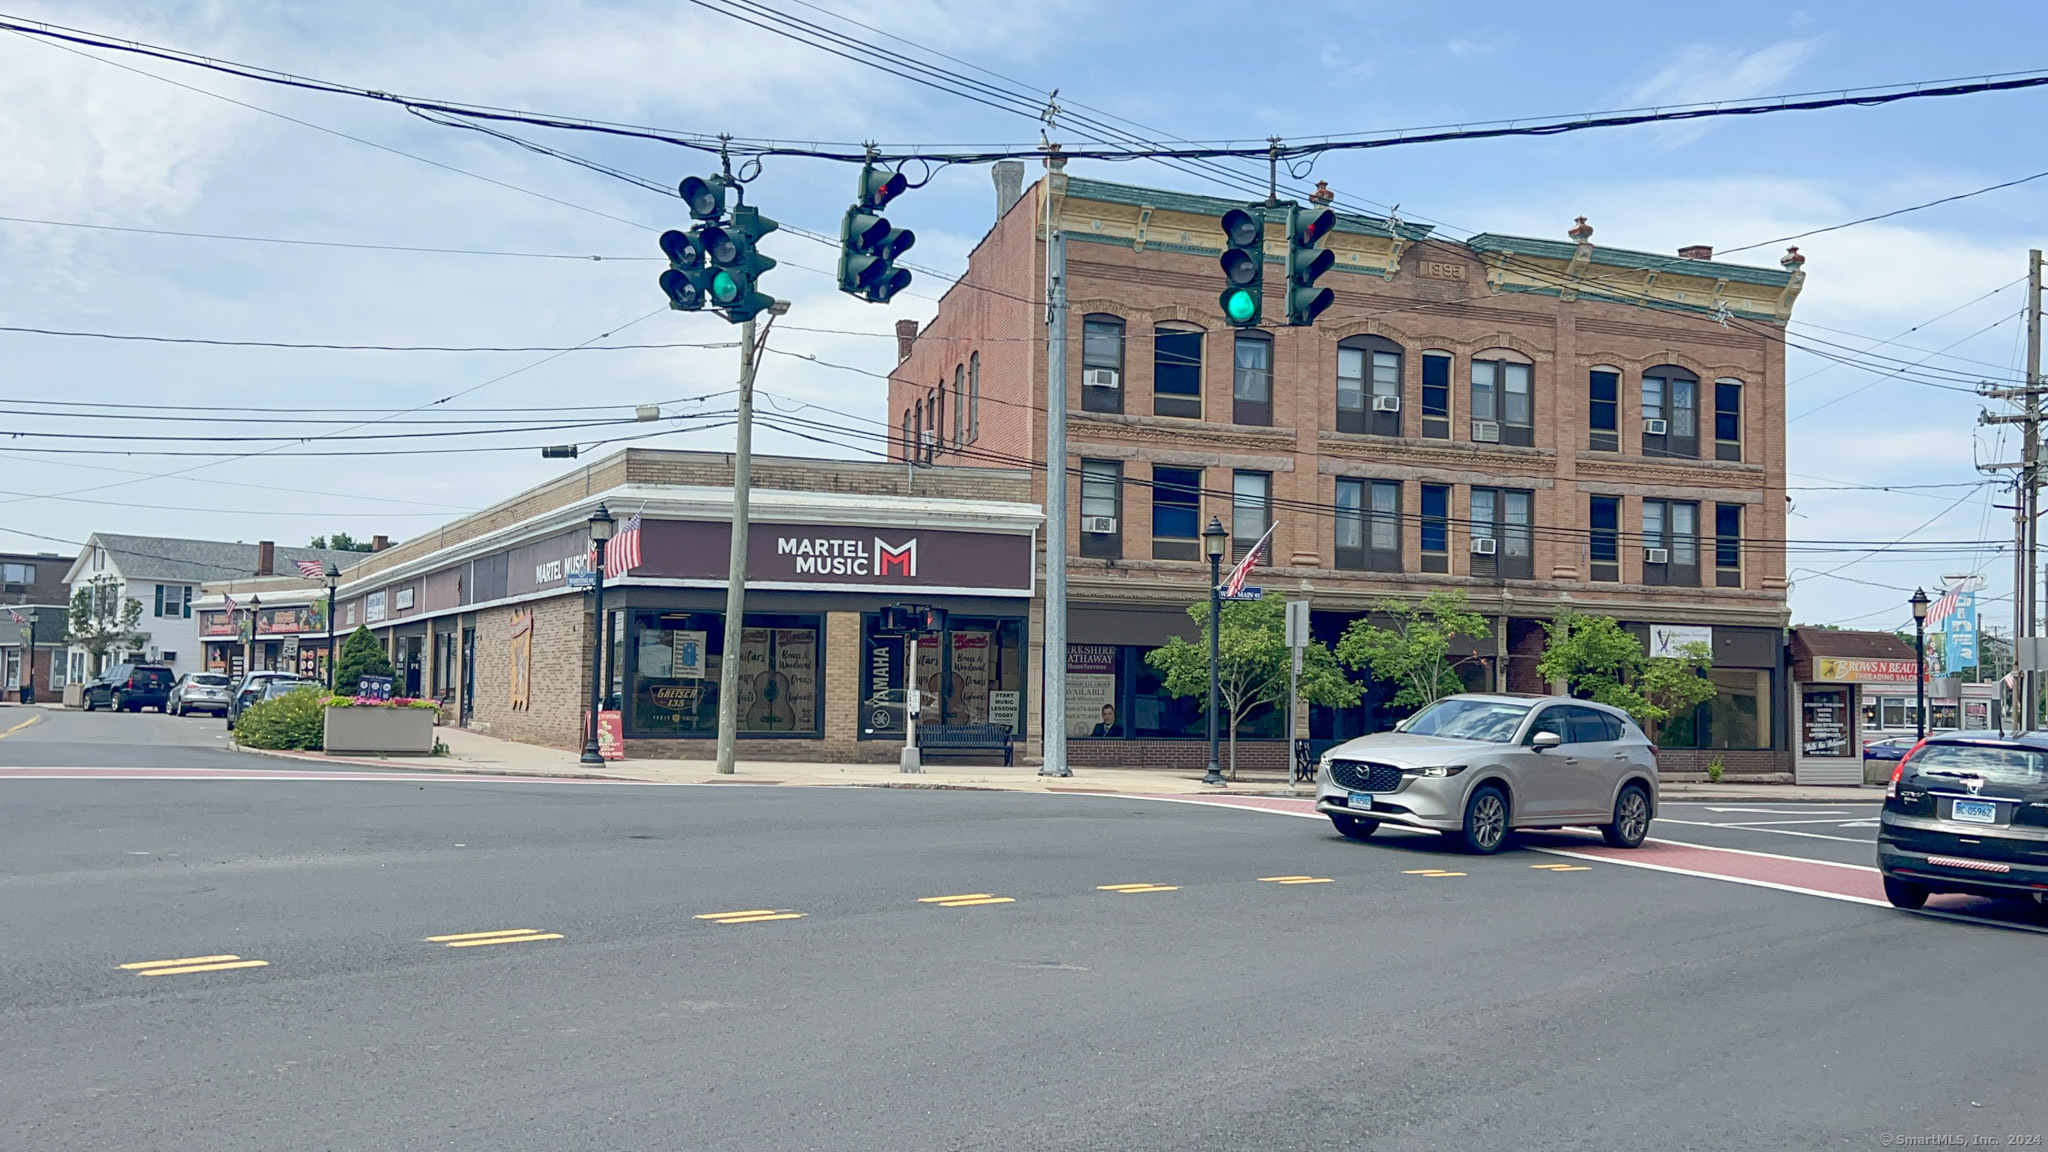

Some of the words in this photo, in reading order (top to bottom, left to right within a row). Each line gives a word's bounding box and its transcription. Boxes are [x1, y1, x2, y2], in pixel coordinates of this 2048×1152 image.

[778, 537, 869, 557] MARTEL
[535, 560, 562, 584] MARTEL
[564, 554, 588, 577] MUSIC
[796, 557, 868, 575] MUSIC
[284, 646, 296, 654] 25
[781, 649, 801, 660] Brass
[1066, 645, 1116, 655] ERKSHIRE
[1067, 654, 1113, 664] ATHAWAY
[1834, 660, 1878, 679] BROWS
[1879, 661, 1887, 672] N
[873, 646, 889, 708] YAMAHA
[1855, 673, 1895, 681] THREADING
[656, 688, 698, 699] GRETSCH
